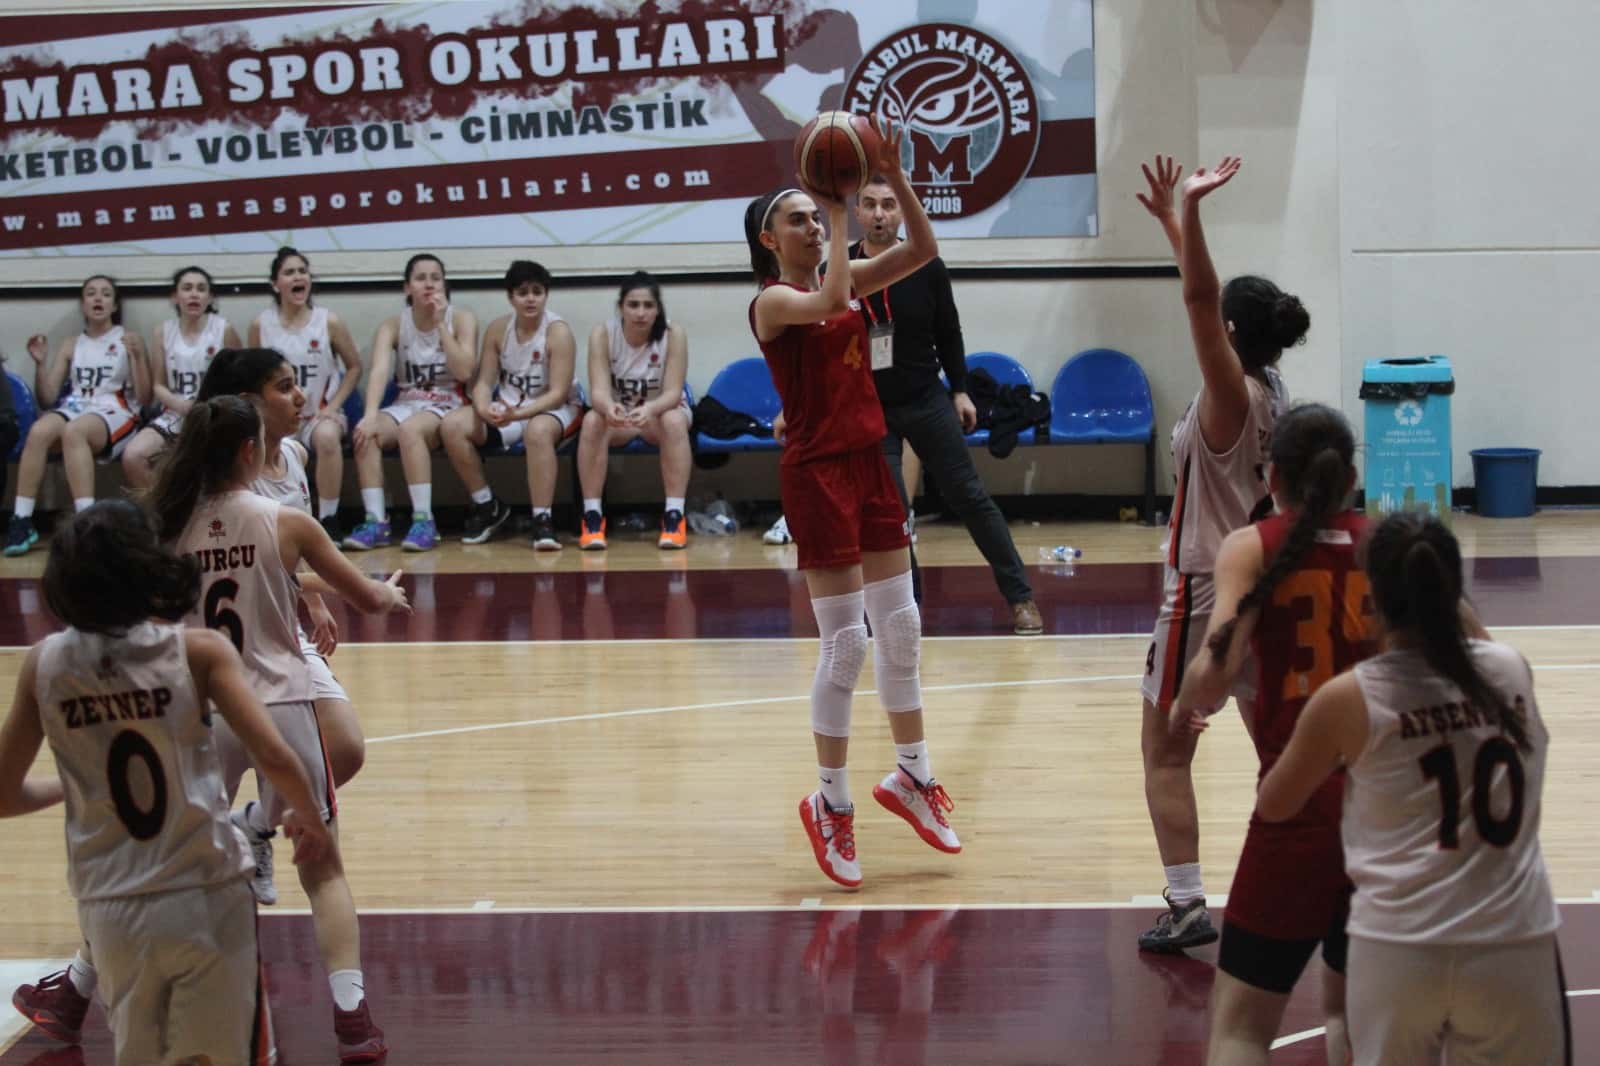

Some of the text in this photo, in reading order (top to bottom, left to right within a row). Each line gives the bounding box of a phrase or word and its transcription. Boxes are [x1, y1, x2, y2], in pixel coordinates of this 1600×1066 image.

[3, 15, 778, 123] MARA SPOR OKULLARI
[936, 29, 1031, 136] MARMARA
[0, 143, 153, 182] KETBOL
[197, 123, 414, 165] VOLEYBOL
[460, 93, 709, 144] CİMNASTİK
[909, 128, 974, 185] M
[923, 196, 962, 214] 2009
[180, 544, 257, 573] URCU
[204, 577, 245, 656] 6
[60, 686, 173, 730] ZEYNEP
[106, 728, 169, 842] 0
[1418, 735, 1526, 851] 10
